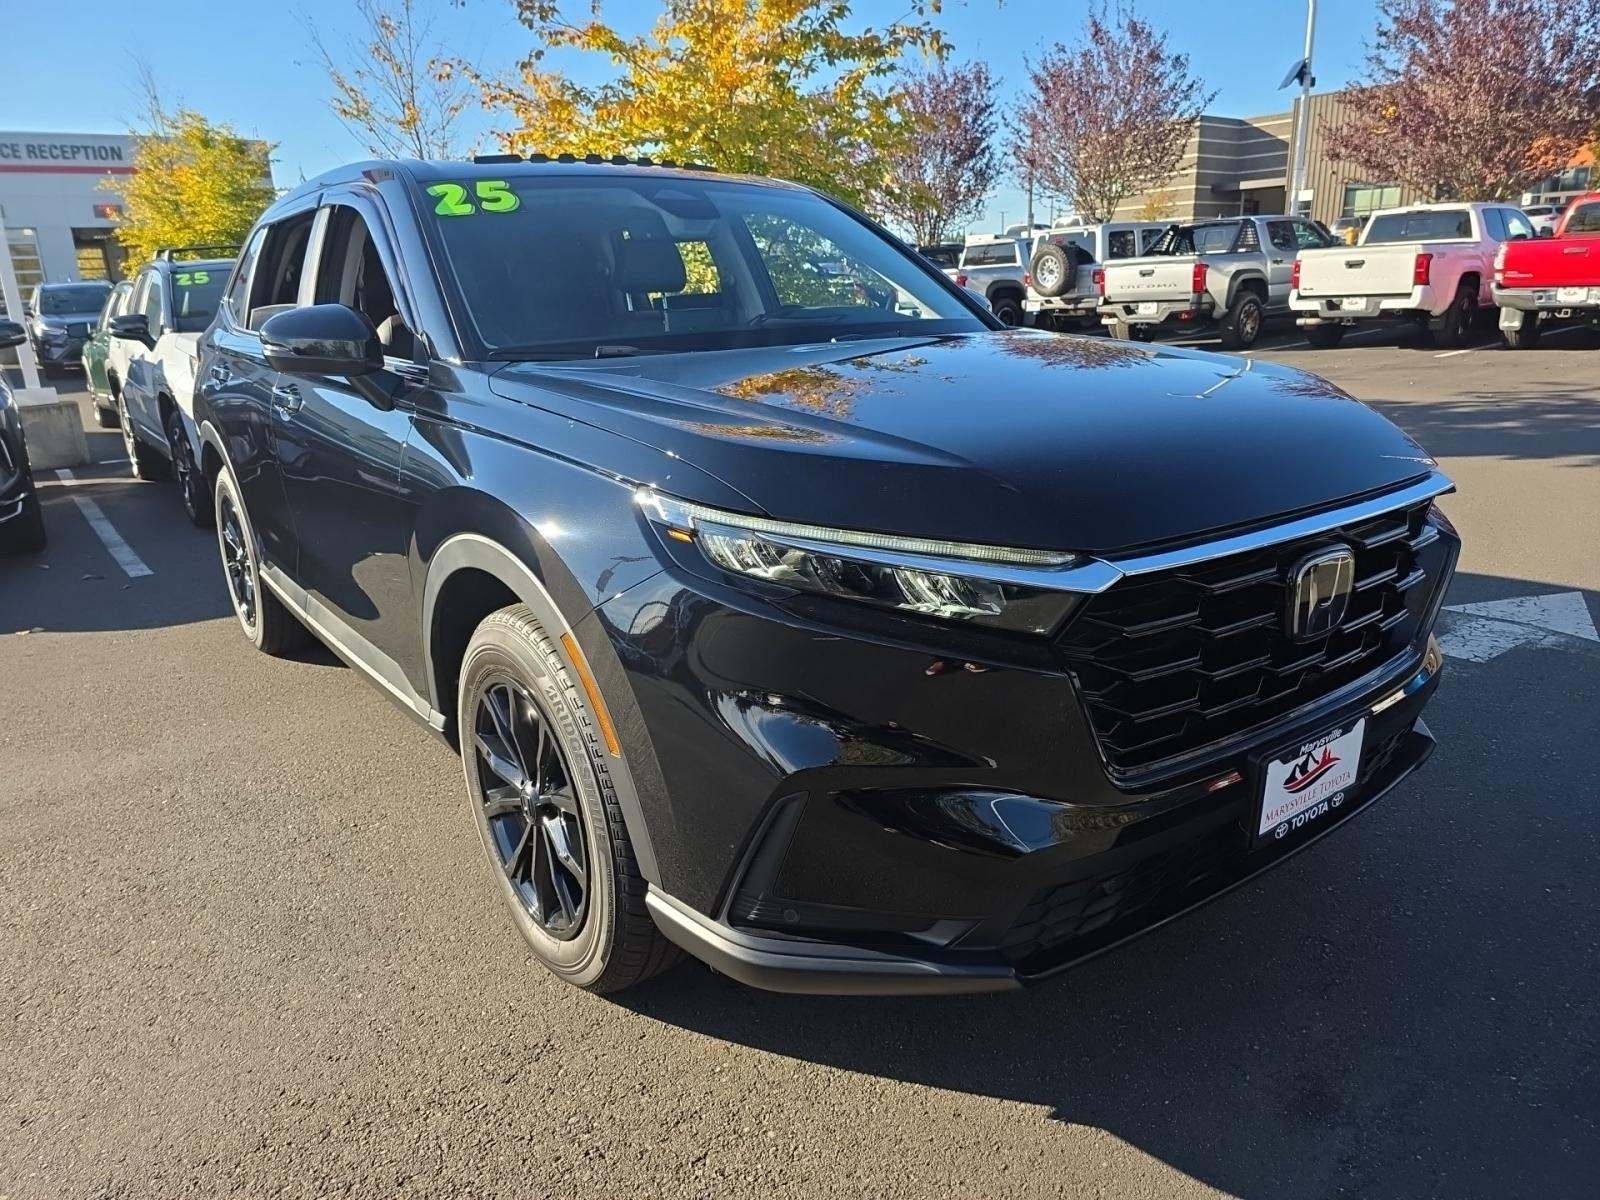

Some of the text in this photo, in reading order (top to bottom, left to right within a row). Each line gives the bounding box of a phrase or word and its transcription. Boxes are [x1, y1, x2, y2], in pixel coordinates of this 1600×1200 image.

[25, 144, 123, 161] RECEPTION
[426, 179, 521, 217] 25
[175, 271, 211, 286] 25
[1299, 728, 1343, 755] Marysville
[1265, 788, 1318, 824] MARYSVILLE
[1320, 770, 1351, 794] TOYOTA
[1291, 801, 1329, 831] TOYOTA
